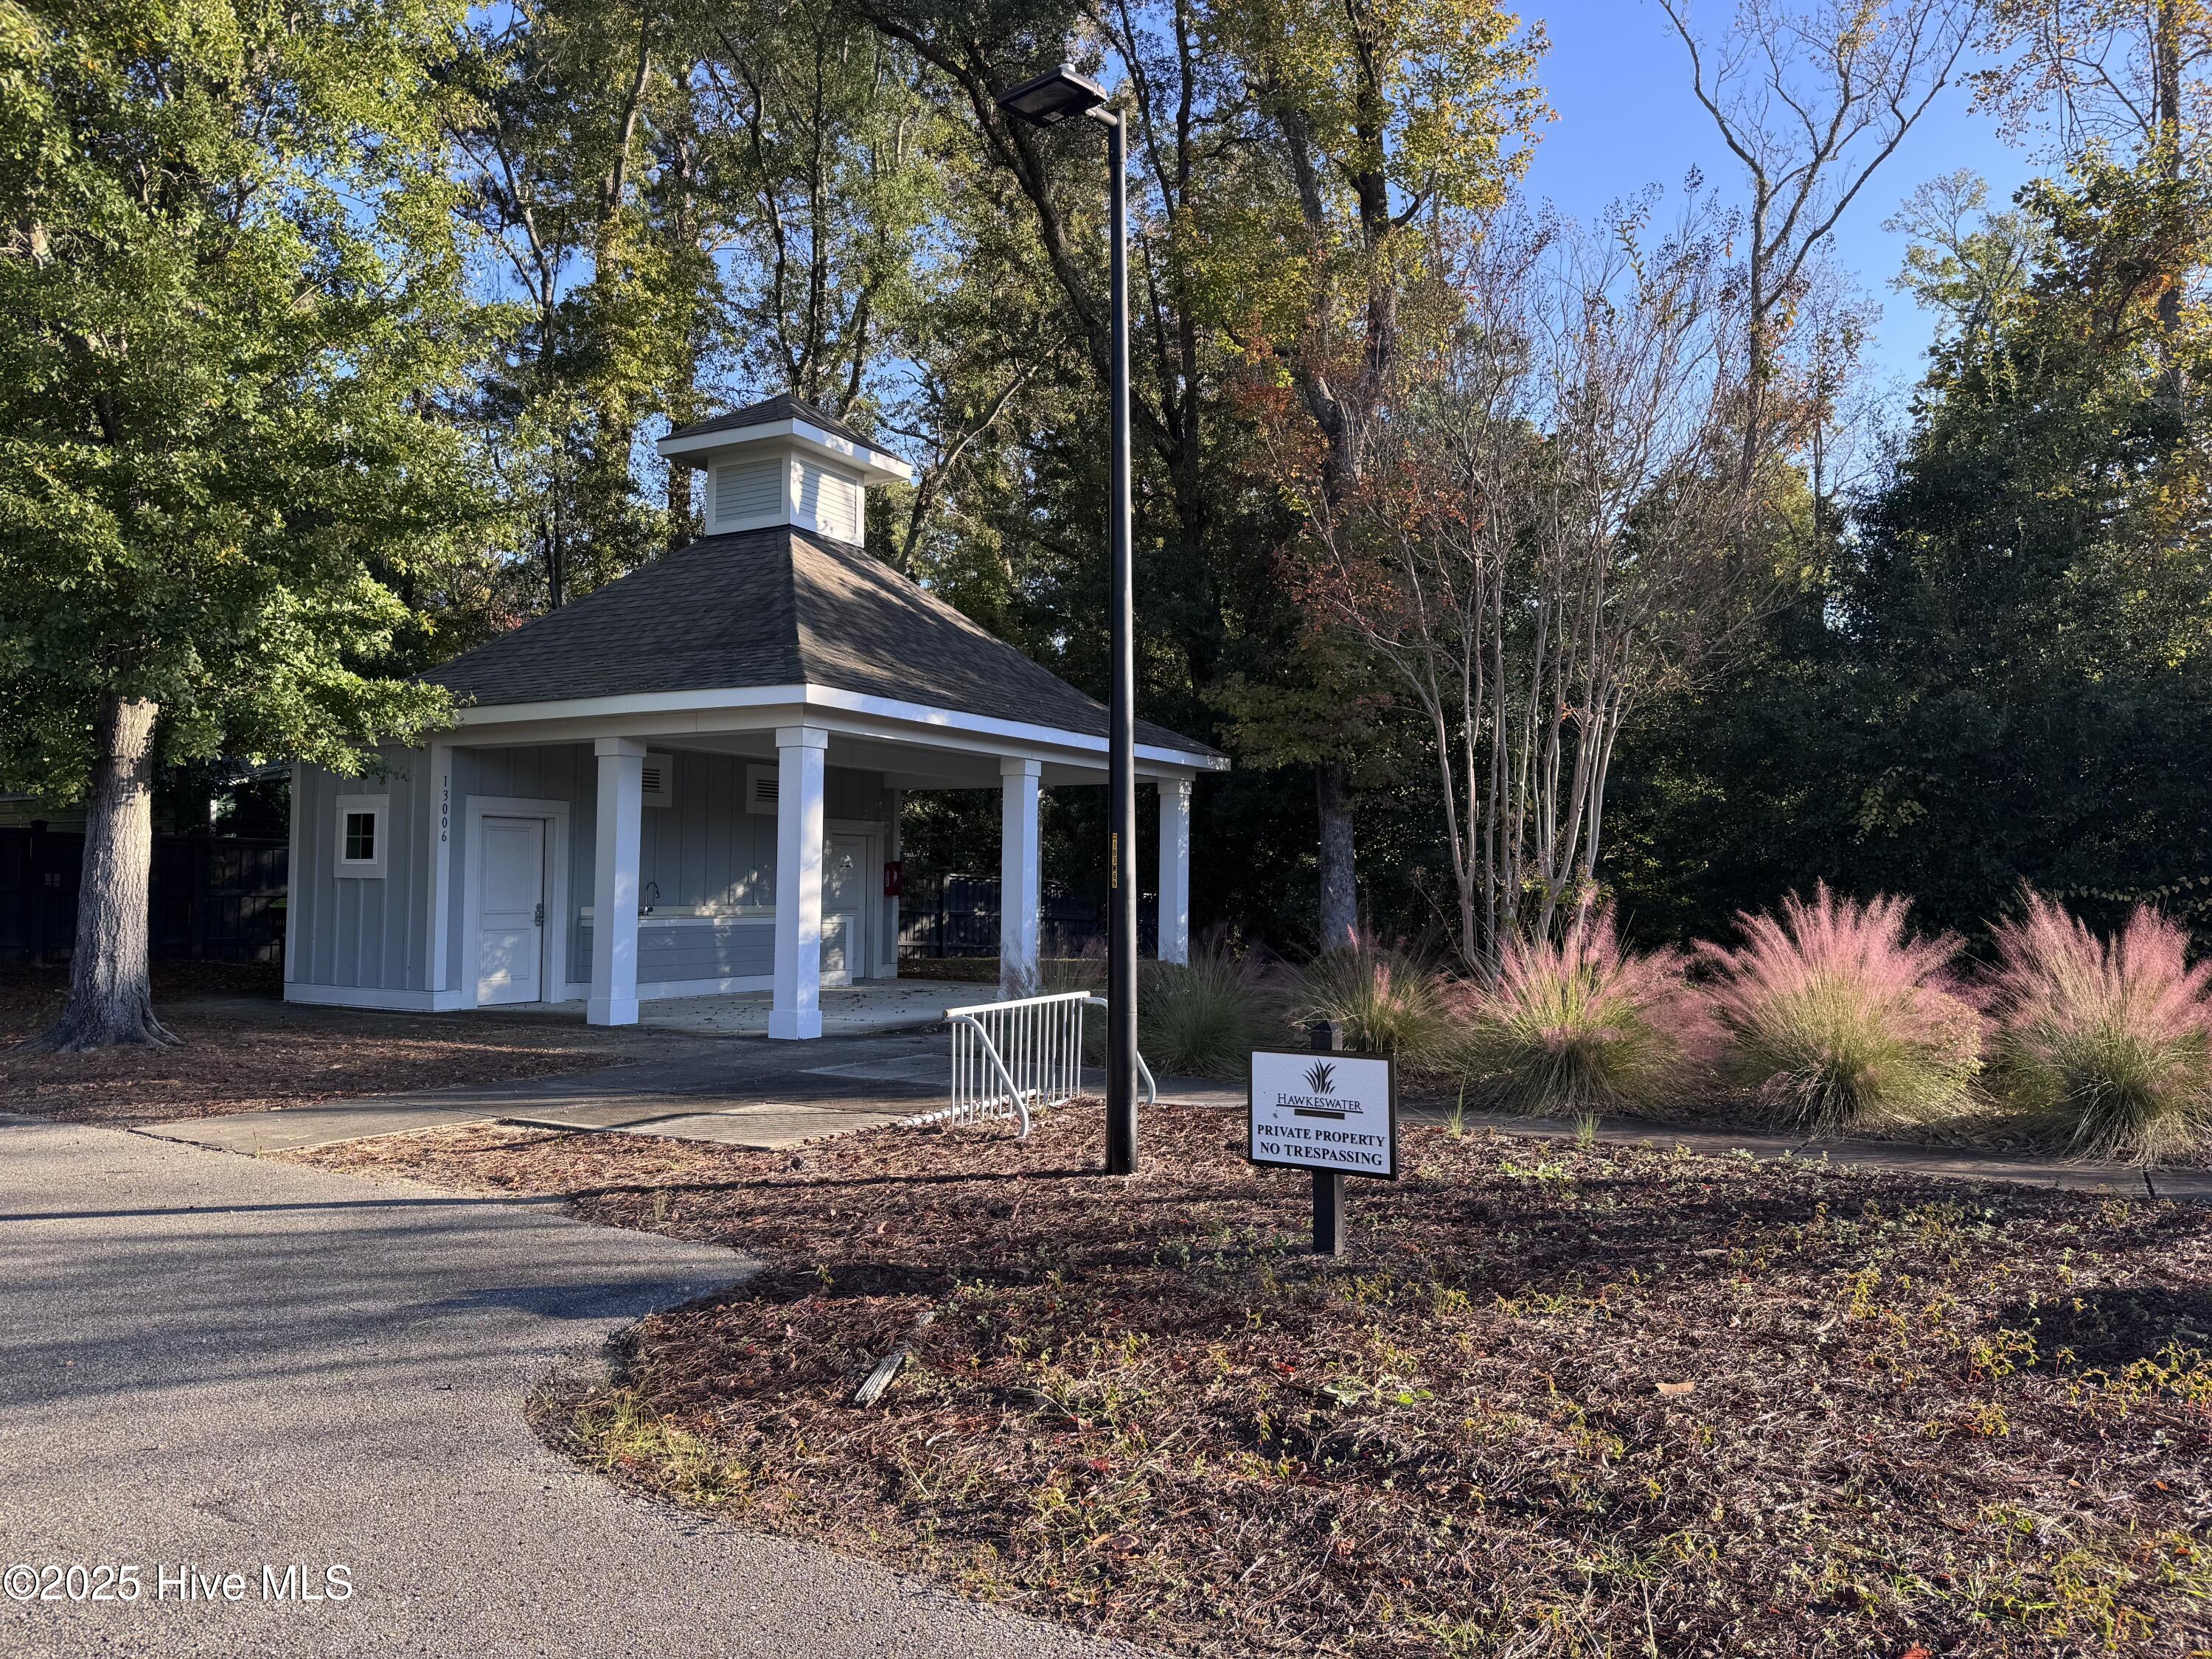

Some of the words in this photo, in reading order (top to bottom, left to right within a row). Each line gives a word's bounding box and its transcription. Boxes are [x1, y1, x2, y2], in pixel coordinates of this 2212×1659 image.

[1277, 1093, 1363, 1110] HAWKESWATER
[1257, 1124, 1311, 1140] PRIVATE
[1315, 1130, 1386, 1147] PROPERTY
[1259, 1141, 1281, 1155] NO
[1284, 1144, 1383, 1166] TRESPASSING
